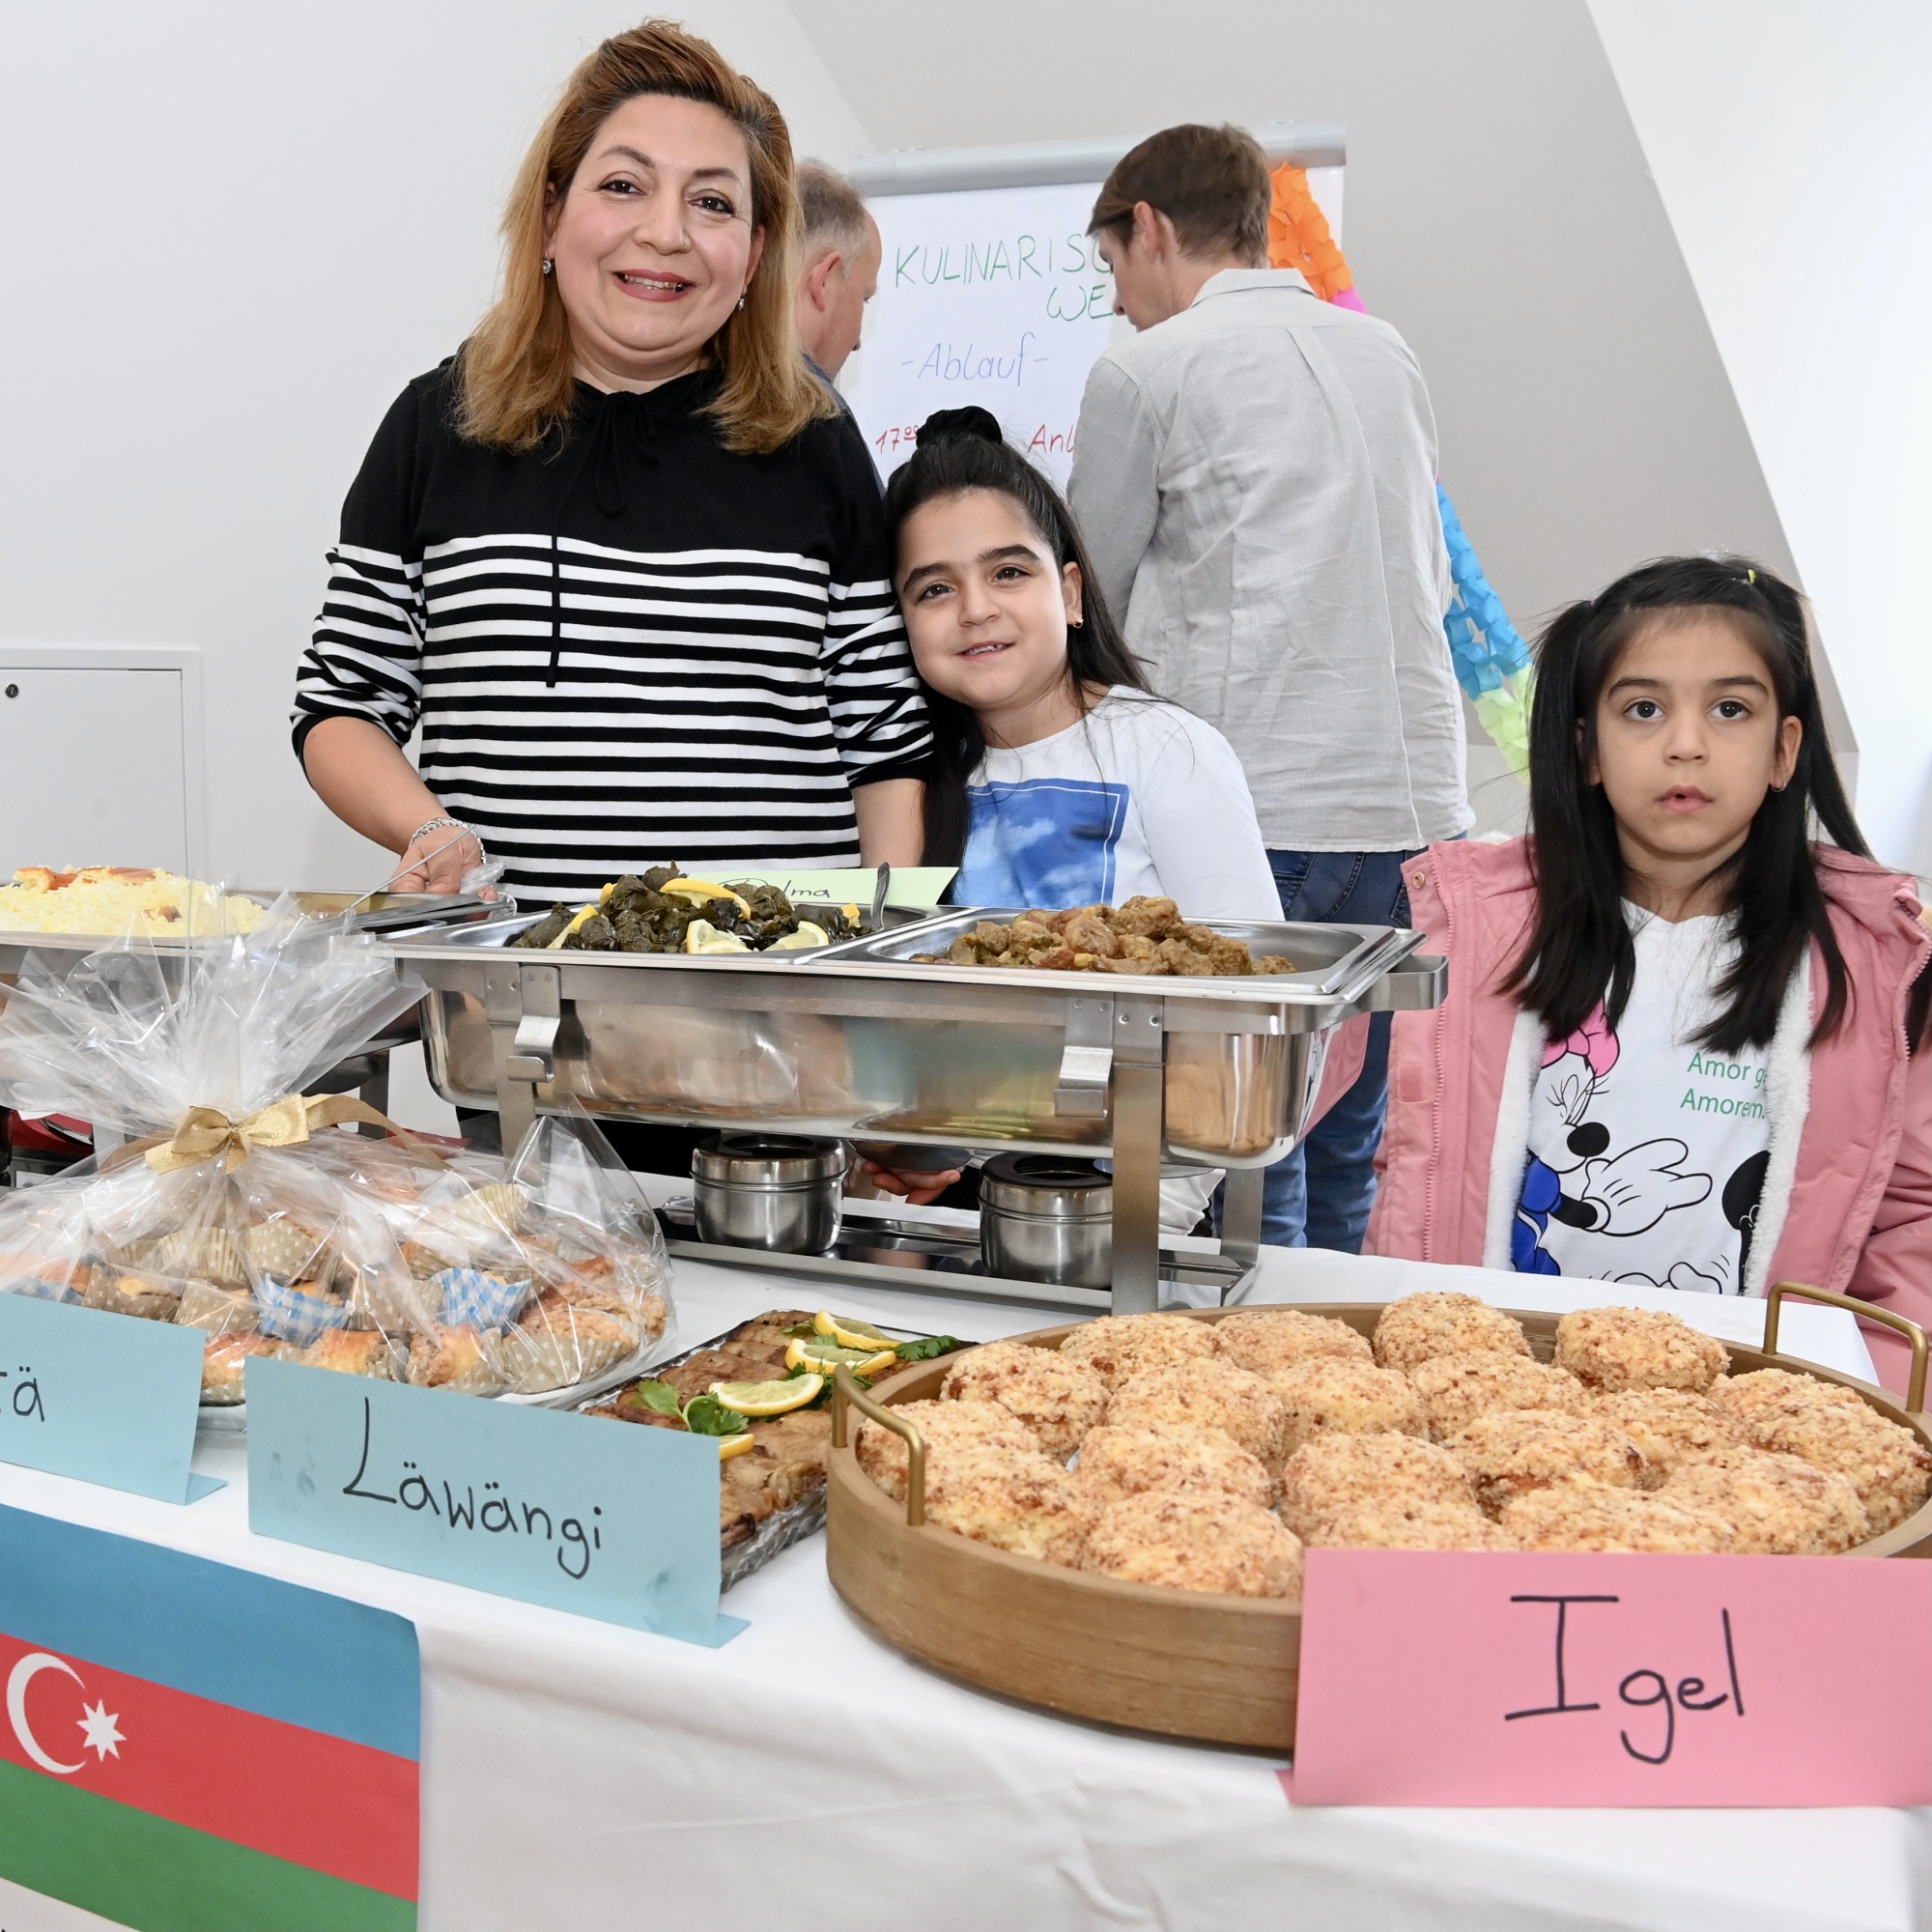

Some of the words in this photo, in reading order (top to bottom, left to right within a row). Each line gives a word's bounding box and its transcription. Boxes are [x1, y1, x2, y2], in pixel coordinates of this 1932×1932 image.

[1687, 1051, 1751, 1080] Amor
[342, 1397, 603, 1579] Läwängi
[1504, 1595, 1745, 1765] Igel
